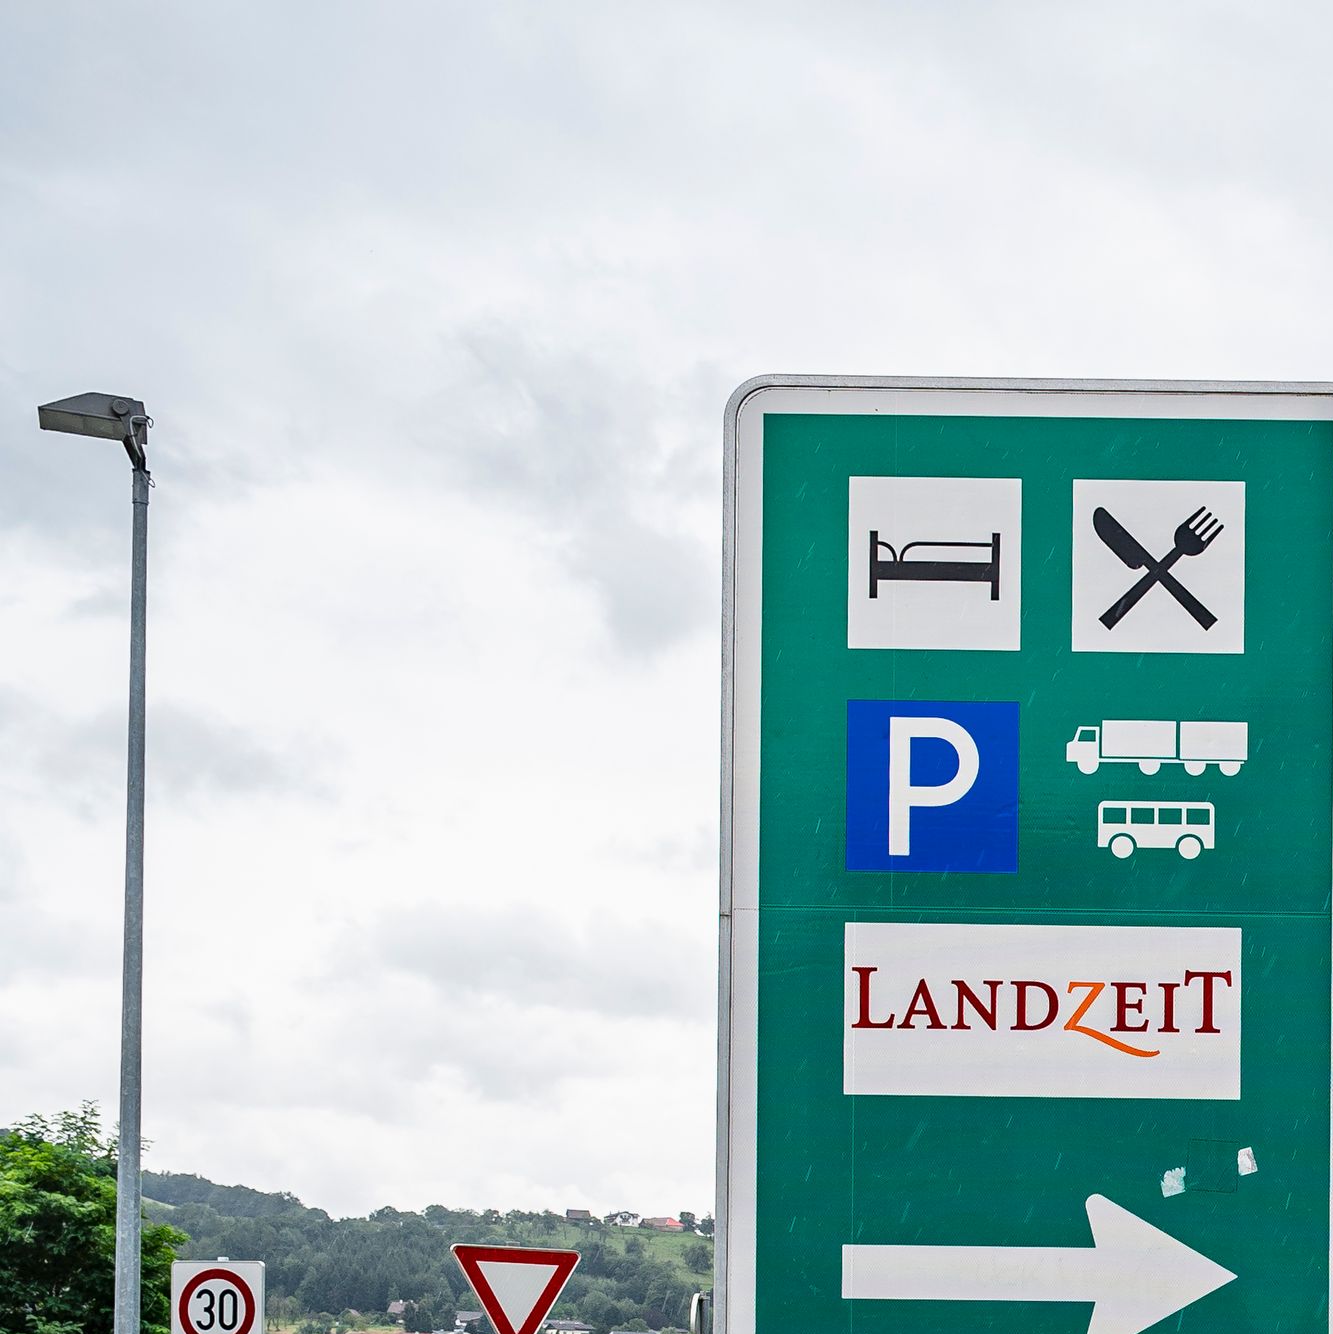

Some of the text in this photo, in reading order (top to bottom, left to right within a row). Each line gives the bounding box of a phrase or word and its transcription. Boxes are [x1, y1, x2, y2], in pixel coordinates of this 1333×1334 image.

[888, 716, 980, 856] P
[851, 966, 1232, 1058] LANDZEIT
[196, 1288, 238, 1331] 30
